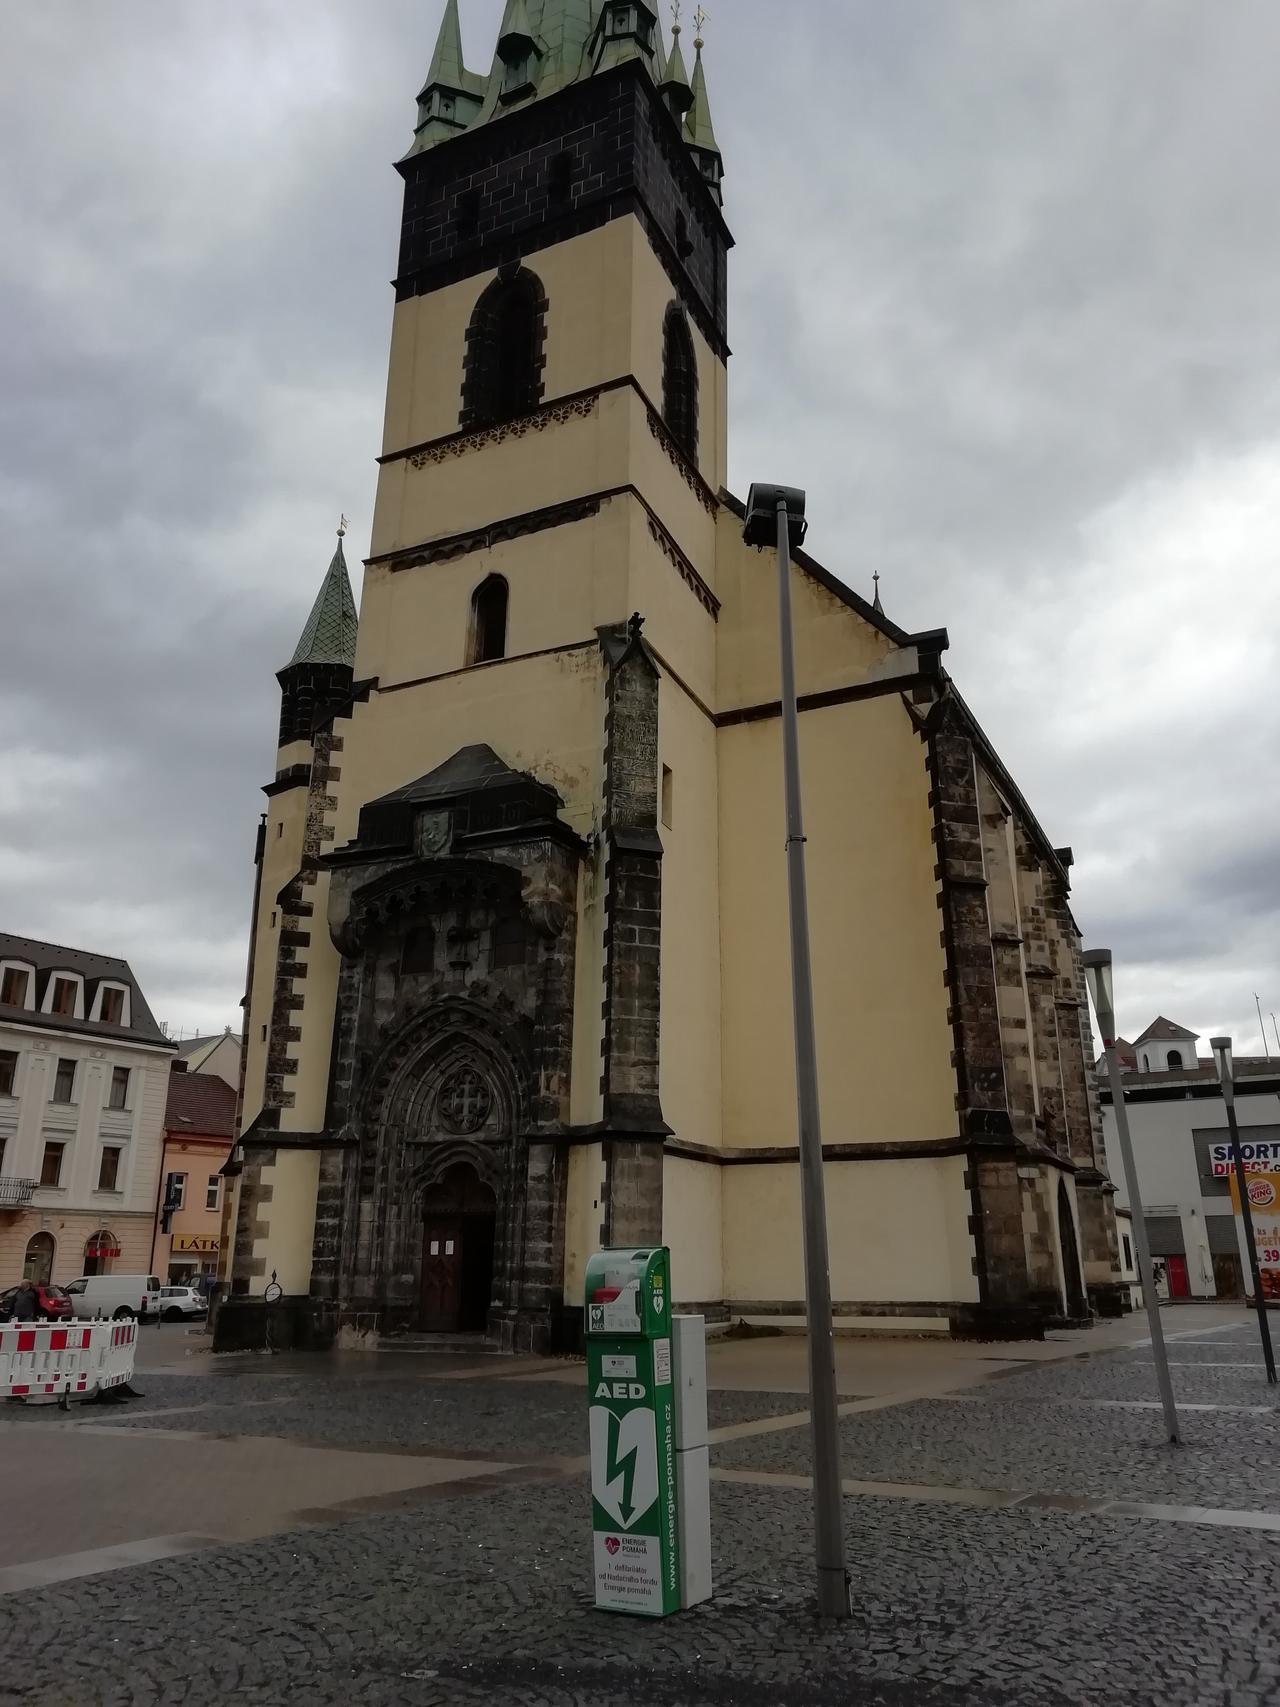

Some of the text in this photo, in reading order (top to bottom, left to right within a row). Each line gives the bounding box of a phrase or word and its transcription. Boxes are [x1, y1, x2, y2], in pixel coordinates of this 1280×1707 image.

[1251, 1188, 1272, 1200] KING
[1264, 1250, 1279, 1262] 39
[592, 1322, 605, 1330] AED
[594, 1382, 646, 1399] AED
[665, 1403, 676, 1591] www.energie-pomaha.cz
[622, 1538, 646, 1546] ENERGIE
[604, 1583, 626, 1593] Energie
